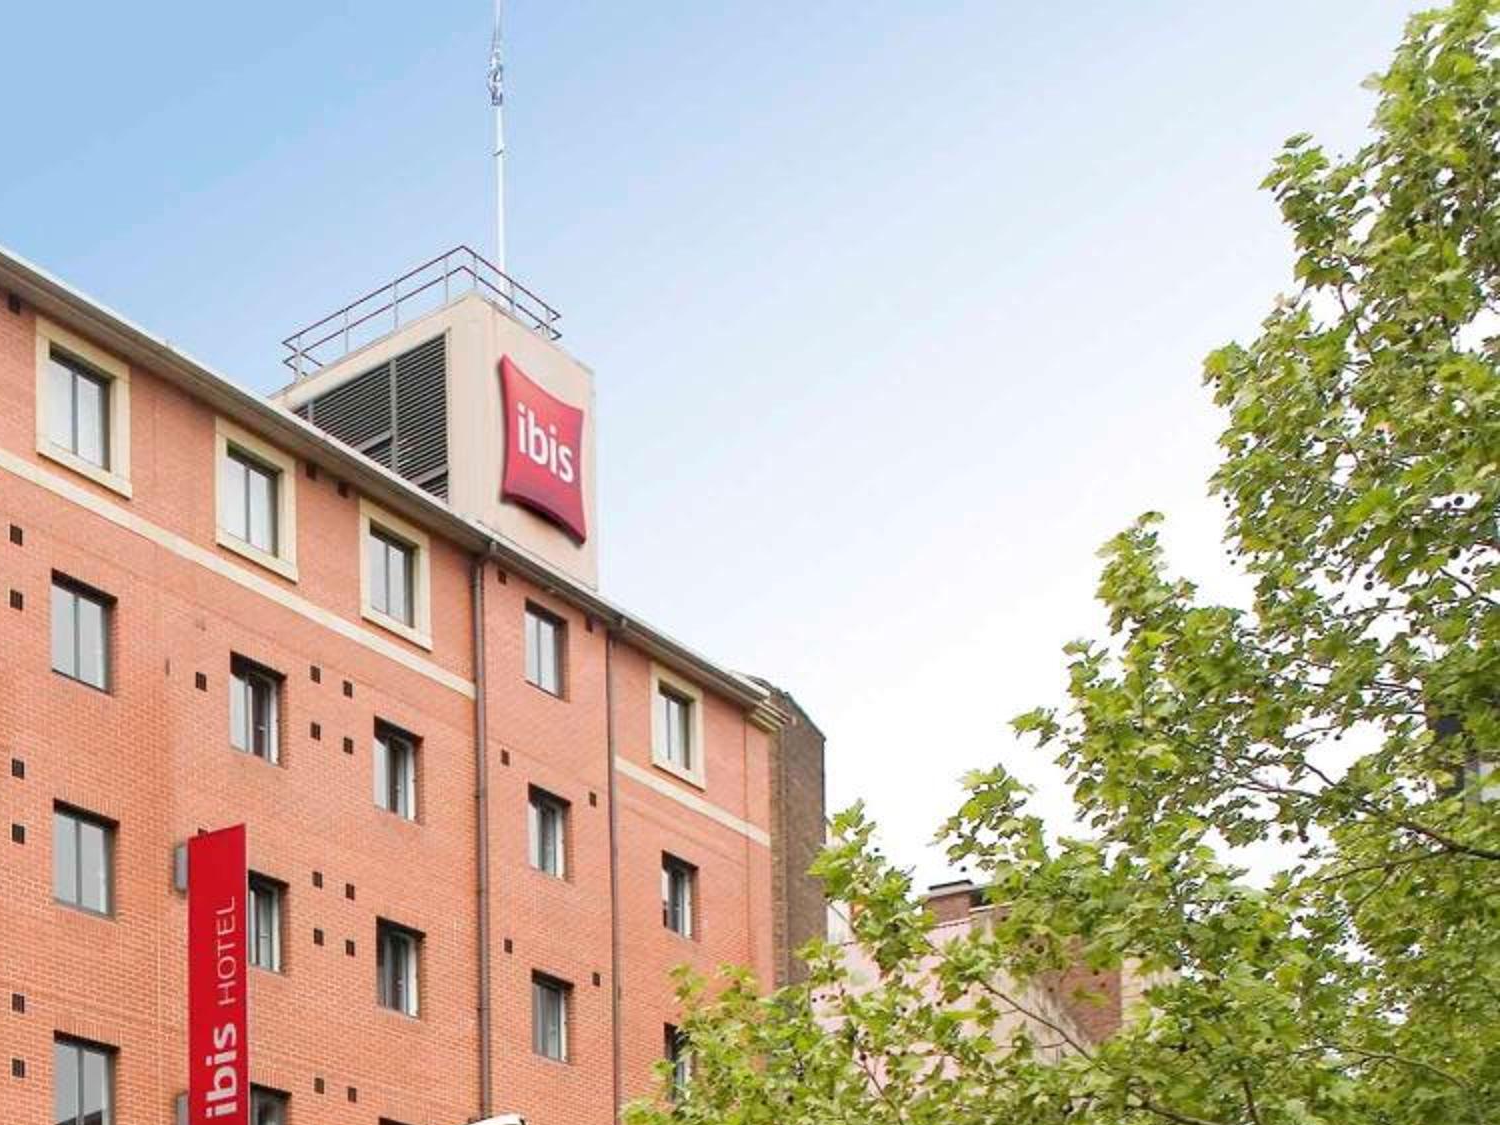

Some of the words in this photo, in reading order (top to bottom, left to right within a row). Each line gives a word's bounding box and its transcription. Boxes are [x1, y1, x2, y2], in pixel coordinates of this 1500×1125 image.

[517, 401, 575, 484] ibis
[216, 897, 237, 1006] HOTEL
[206, 1023, 237, 1119] ibis
